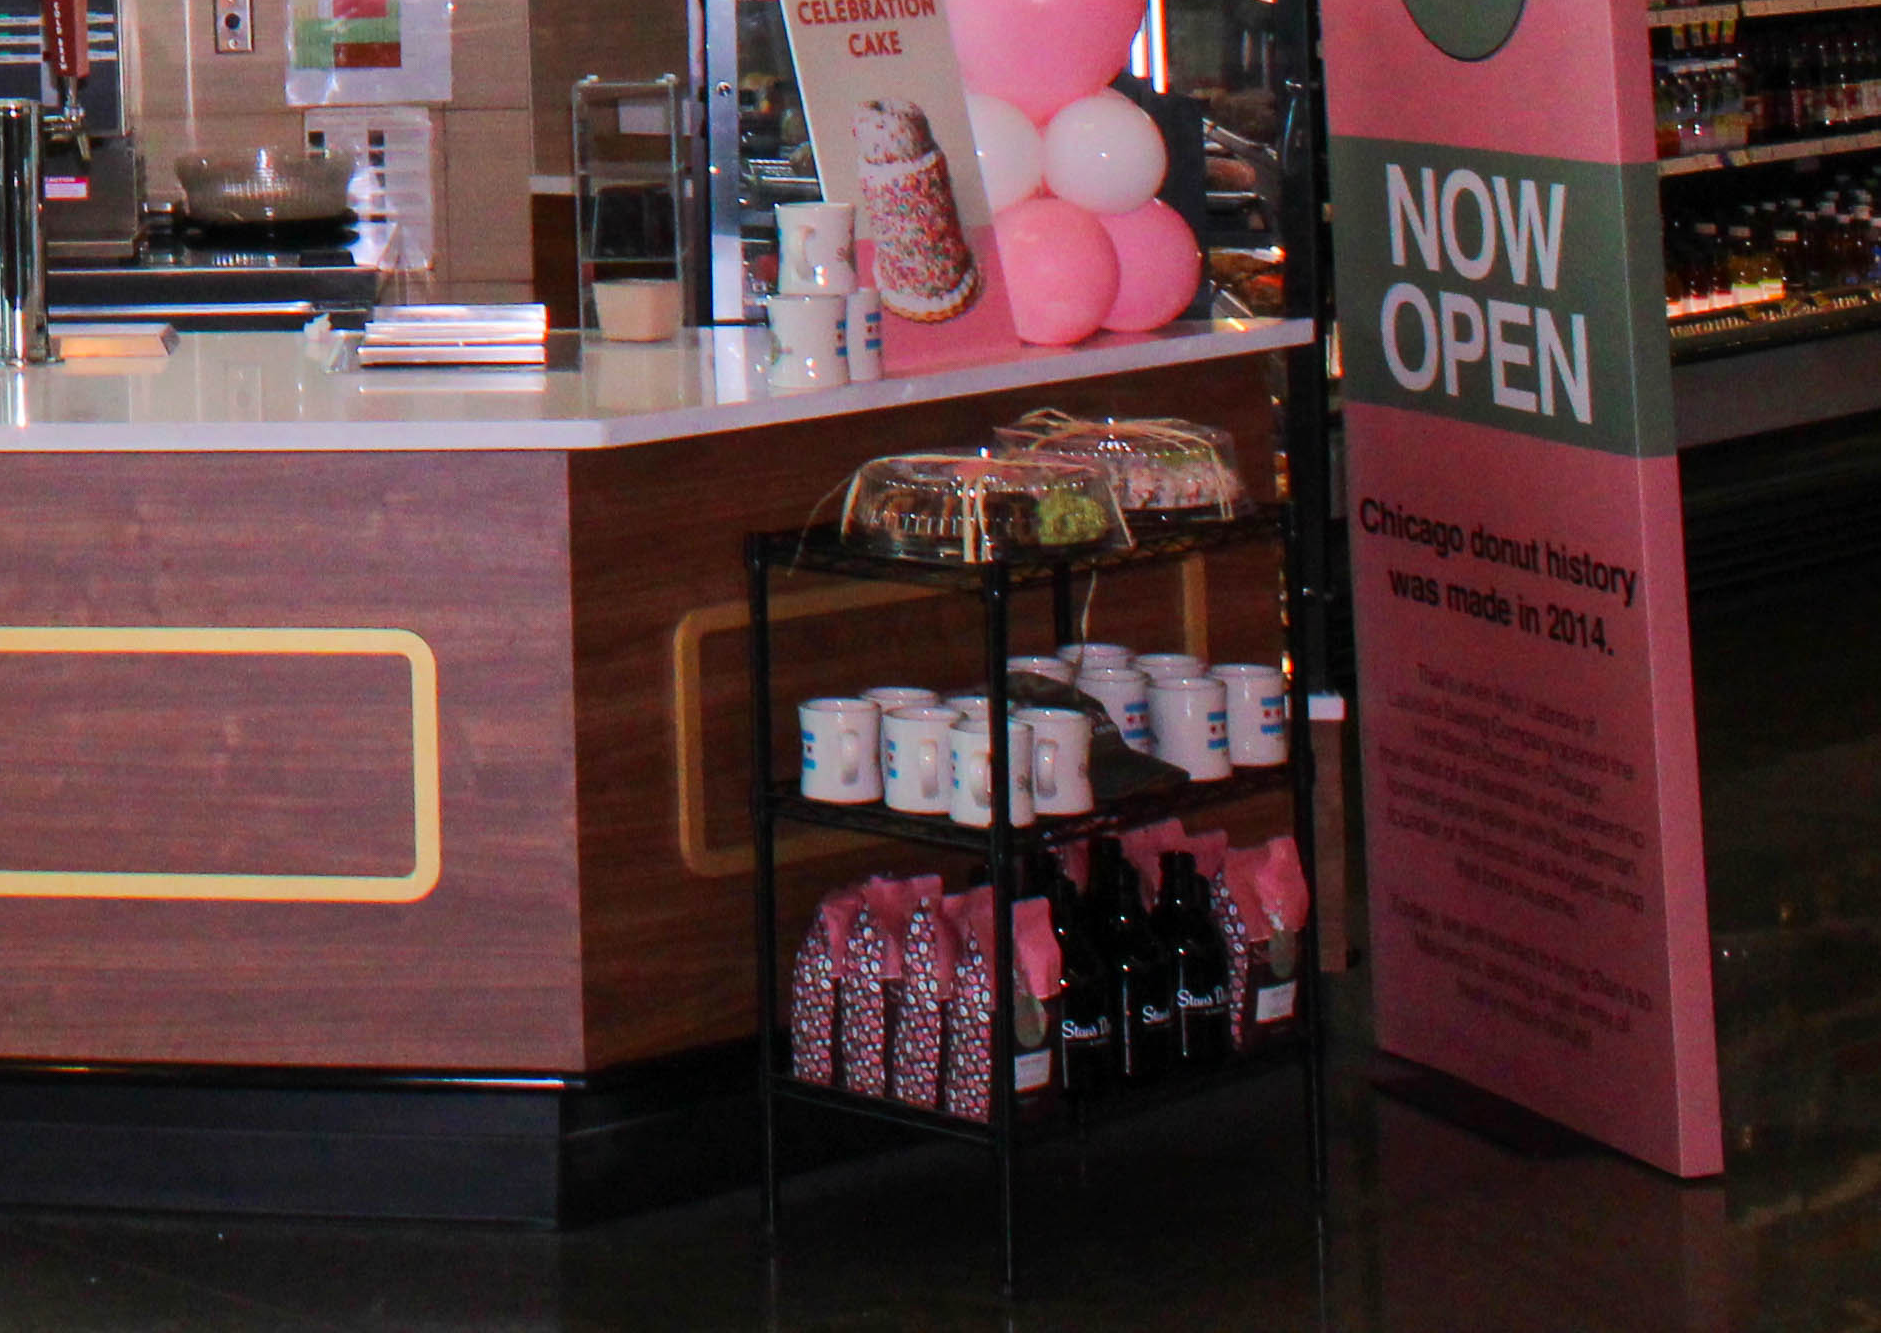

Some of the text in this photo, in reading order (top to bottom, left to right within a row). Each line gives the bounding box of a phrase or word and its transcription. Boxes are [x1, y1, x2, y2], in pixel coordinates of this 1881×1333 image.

[848, 30, 904, 58] CAKE
[1384, 162, 1567, 291] NOW
[1380, 281, 1594, 426] OPEN
[1359, 497, 1638, 607] Chicago donut history
[1389, 569, 1615, 657] was made in 2014.
